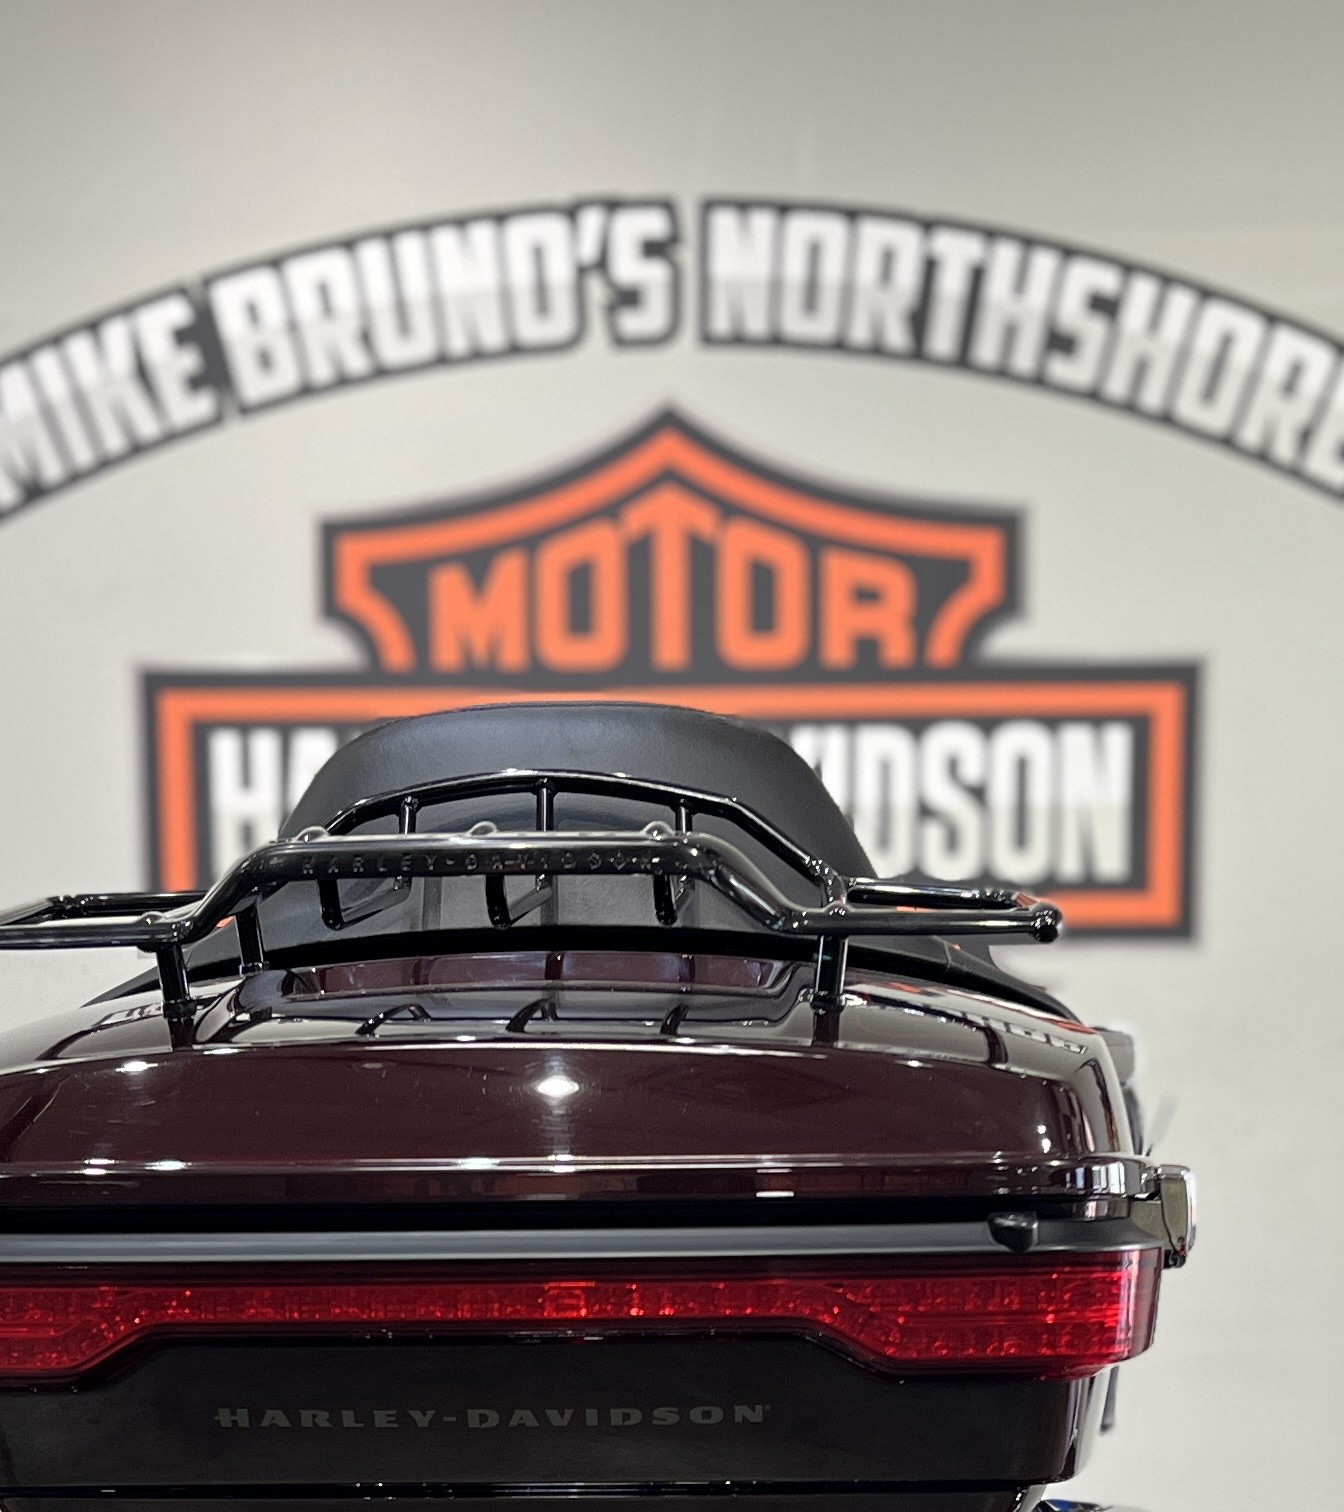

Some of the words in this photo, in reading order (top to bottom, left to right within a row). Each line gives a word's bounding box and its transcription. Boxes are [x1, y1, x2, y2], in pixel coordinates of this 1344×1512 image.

[202, 198, 677, 416] BRUNO'S
[428, 492, 918, 673] MOTOR
[214, 1404, 764, 1428] HARLEY-DAVIDSON
